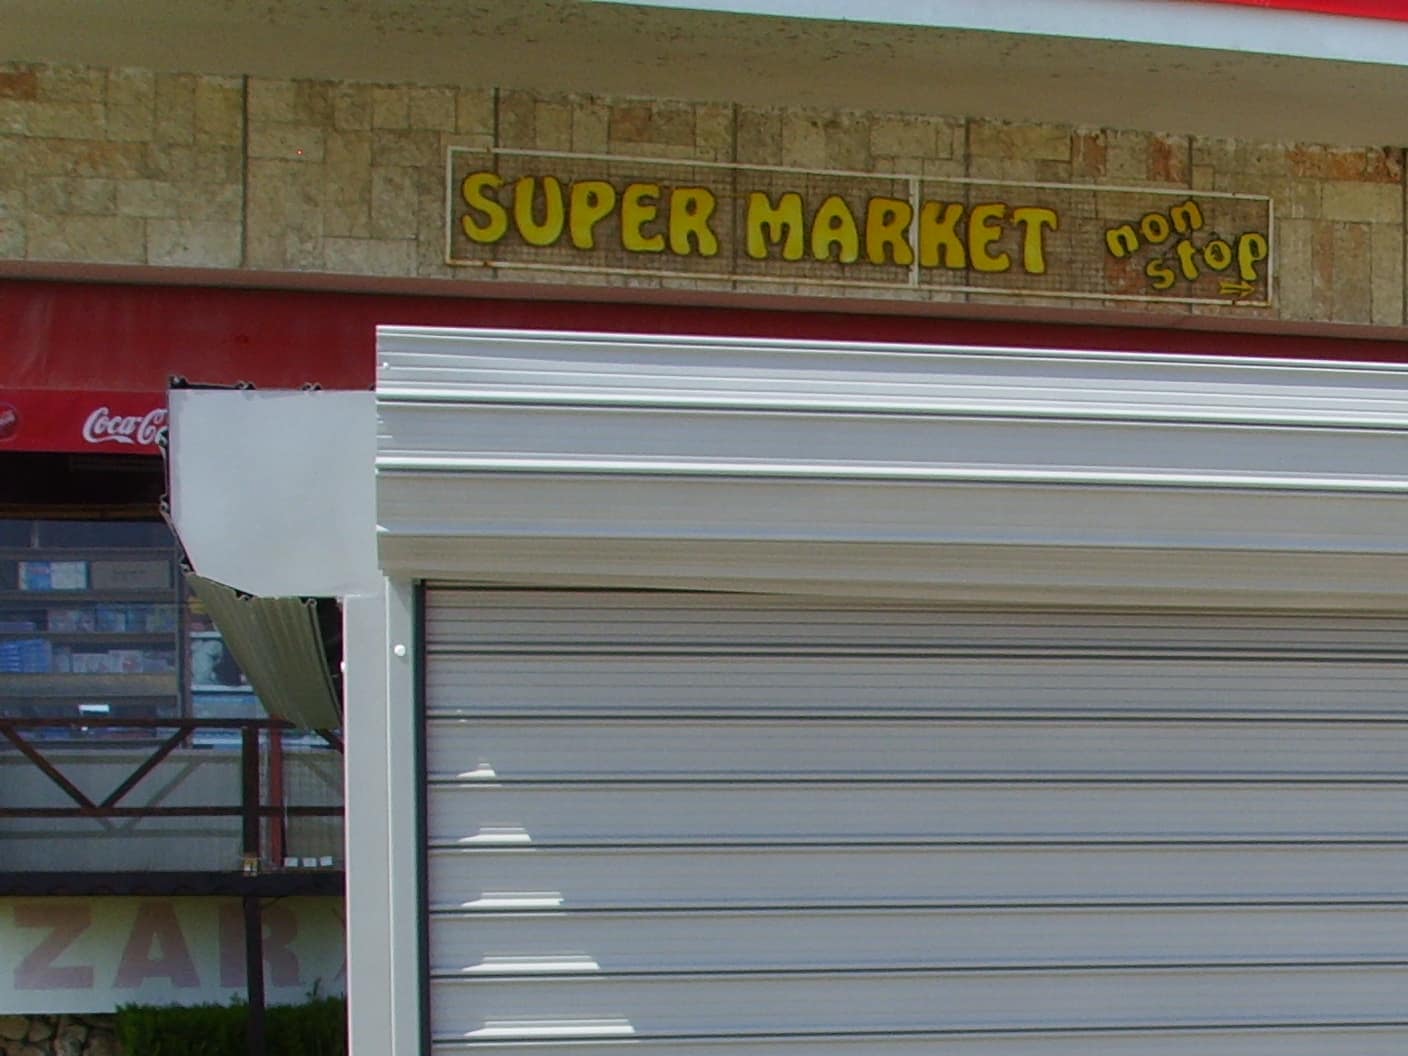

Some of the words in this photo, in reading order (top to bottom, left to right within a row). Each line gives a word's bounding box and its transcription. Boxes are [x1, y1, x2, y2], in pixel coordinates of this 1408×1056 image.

[461, 171, 719, 257] SUPER
[746, 191, 1058, 274] MARKET
[1106, 201, 1203, 258] non
[1146, 232, 1268, 289] stop
